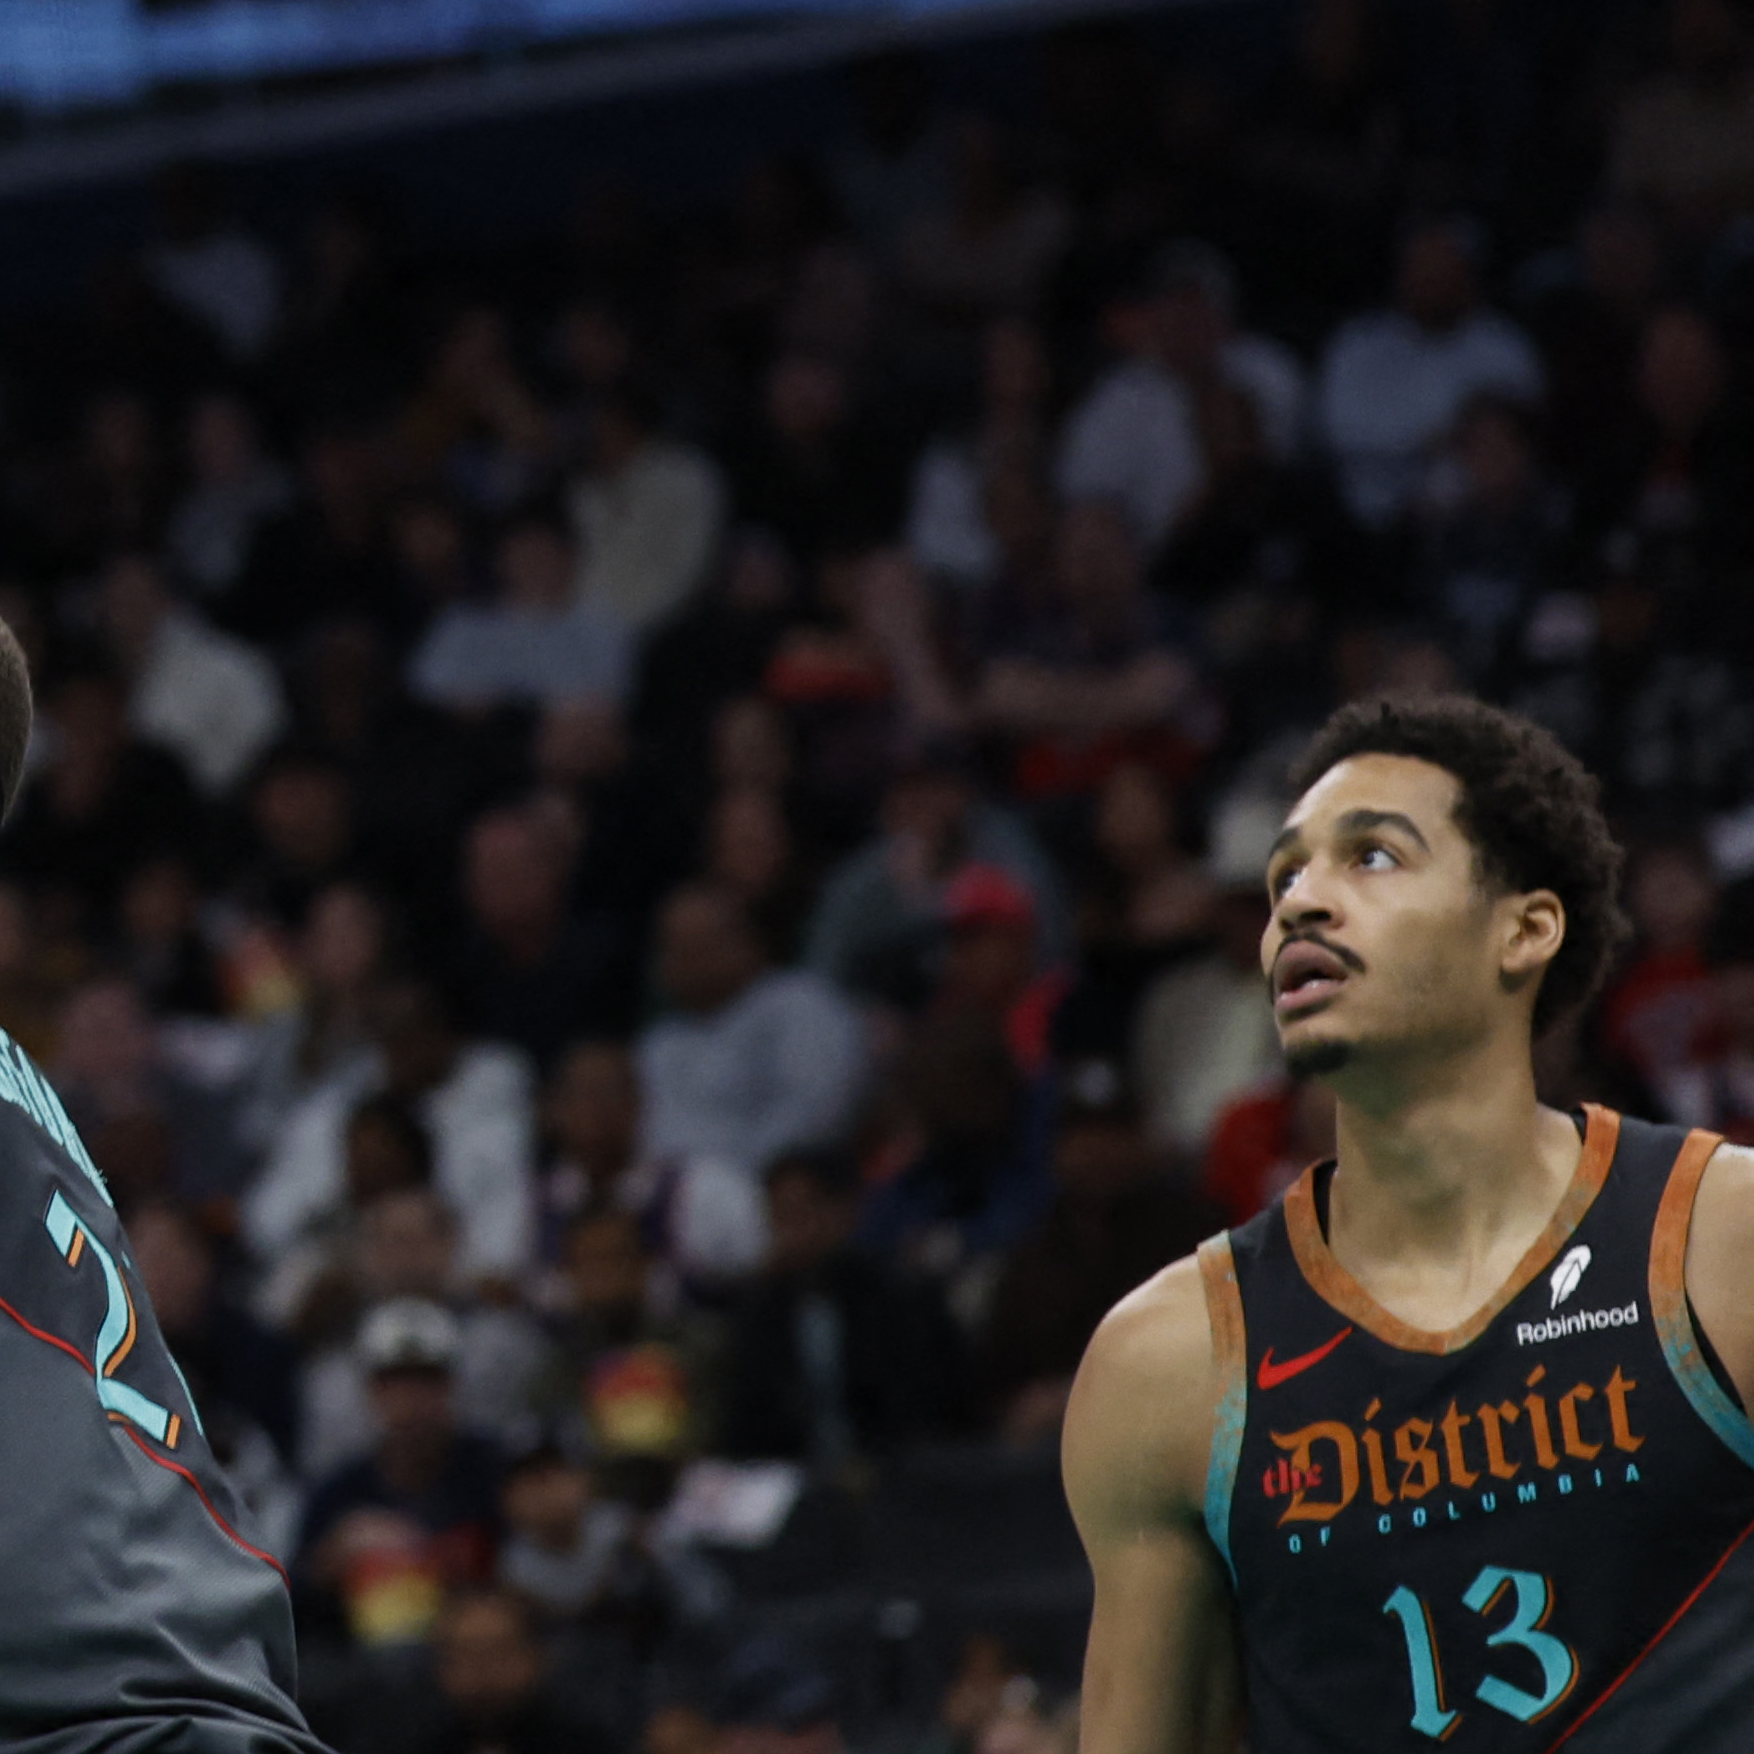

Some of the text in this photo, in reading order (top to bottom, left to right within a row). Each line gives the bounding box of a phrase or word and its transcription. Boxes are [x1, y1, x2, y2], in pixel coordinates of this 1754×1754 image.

[44, 1188, 204, 1452] 2
[1516, 1301, 1640, 1346] Robinhood
[1261, 1457, 1323, 1498] the
[1269, 1363, 1646, 1528] District
[1288, 1462, 1641, 1553] OF COLUMBIA
[1383, 1564, 1582, 1742] 13
